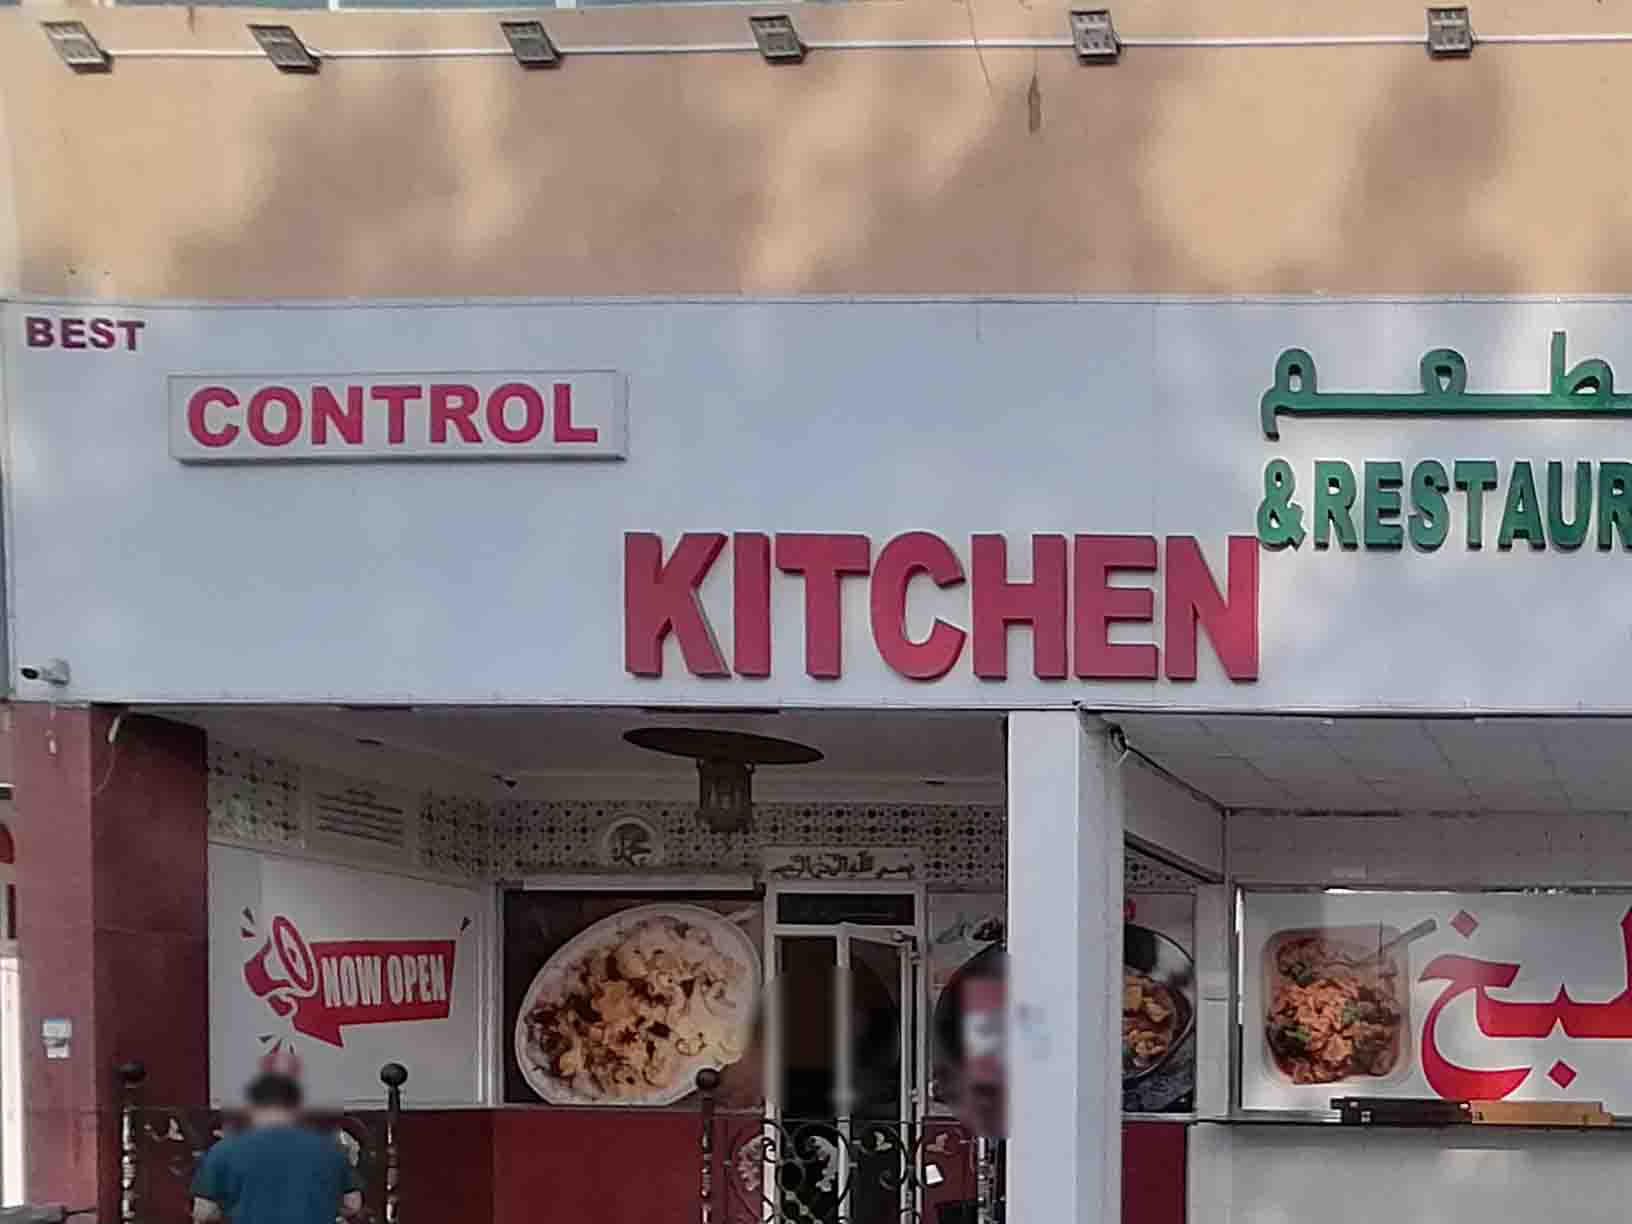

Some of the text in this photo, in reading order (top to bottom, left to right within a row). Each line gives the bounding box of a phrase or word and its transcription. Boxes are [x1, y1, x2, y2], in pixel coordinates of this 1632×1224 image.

[25, 316, 145, 351] BEST
[187, 383, 599, 448] CONTROL
[624, 531, 1260, 682] KITCHEN
[320, 953, 448, 1009] NOW OPEN
